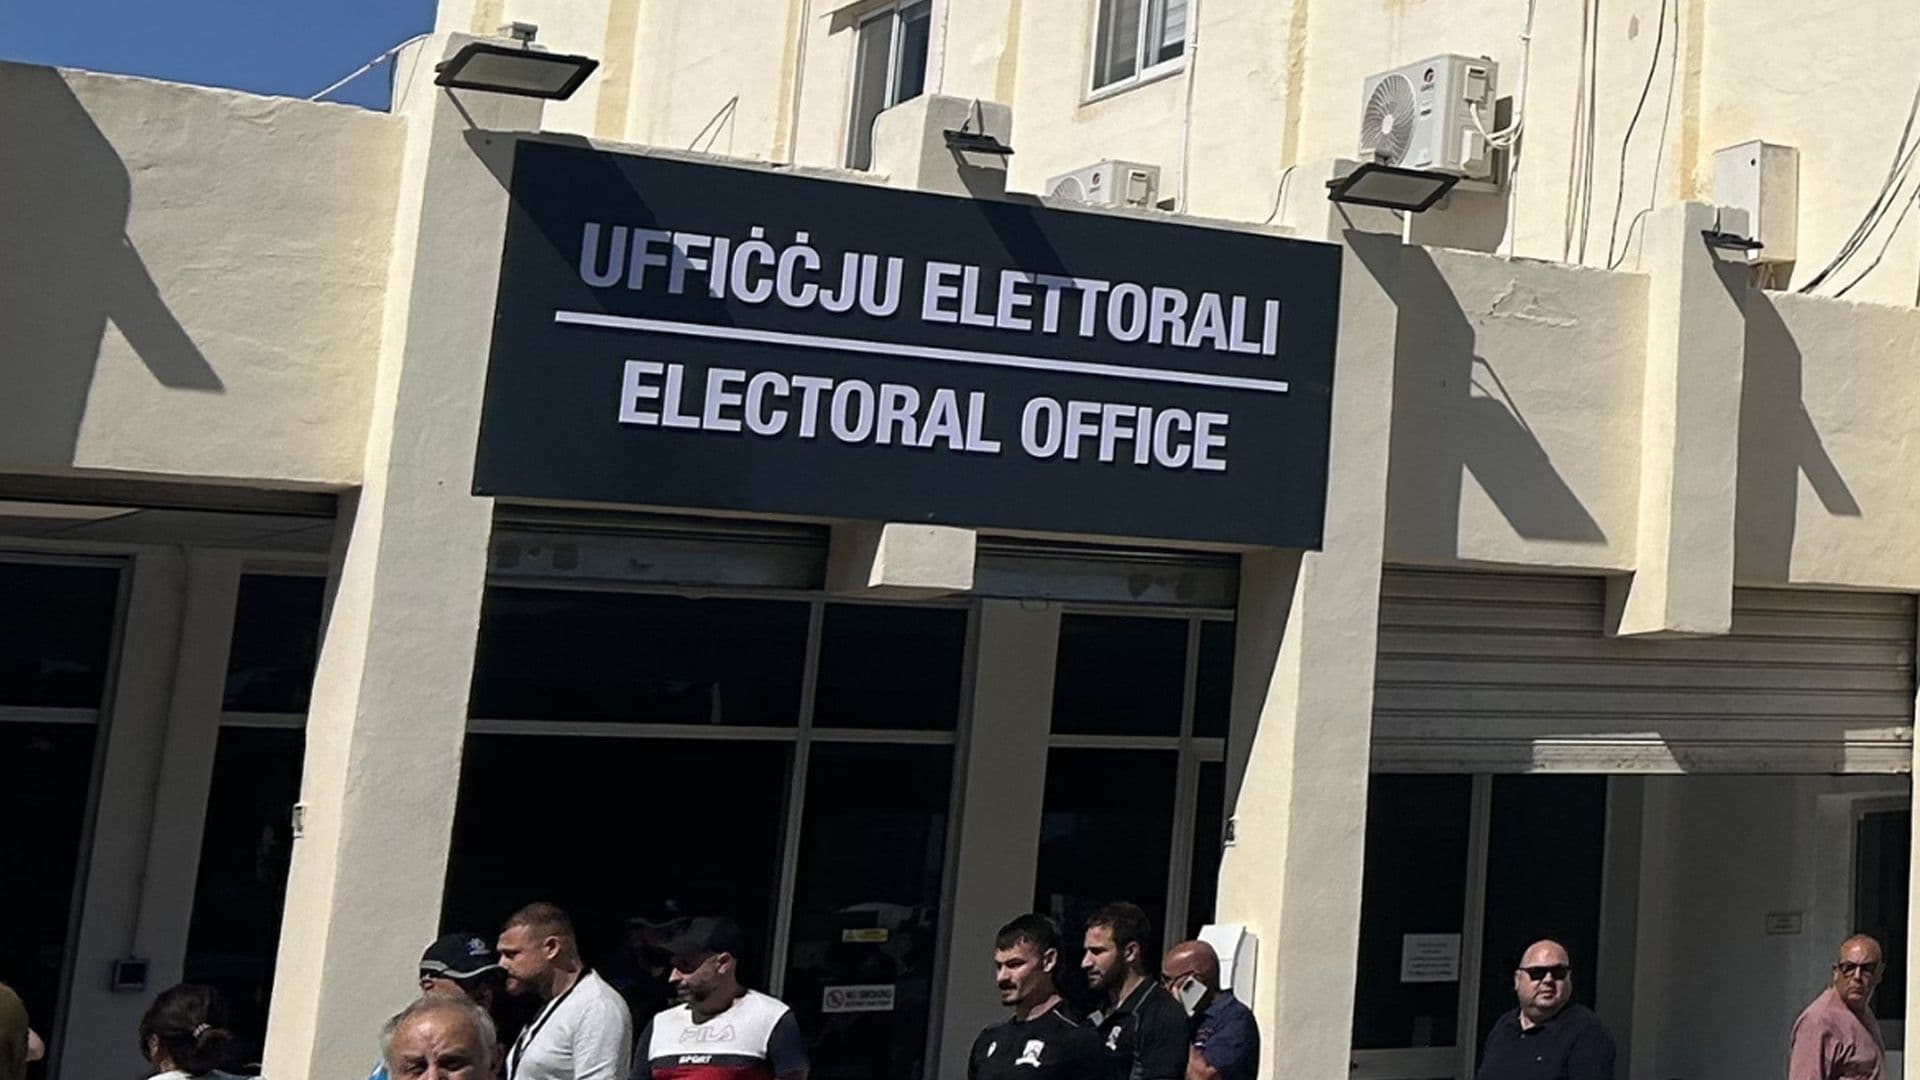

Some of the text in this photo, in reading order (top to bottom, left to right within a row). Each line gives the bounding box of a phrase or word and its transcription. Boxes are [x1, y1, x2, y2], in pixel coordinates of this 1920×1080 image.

[580, 224, 1280, 356] UFFIĊĊJU ELETTORALI
[619, 360, 1229, 471] ELECTORAL OFFICE
[680, 1024, 736, 1042] FILA
